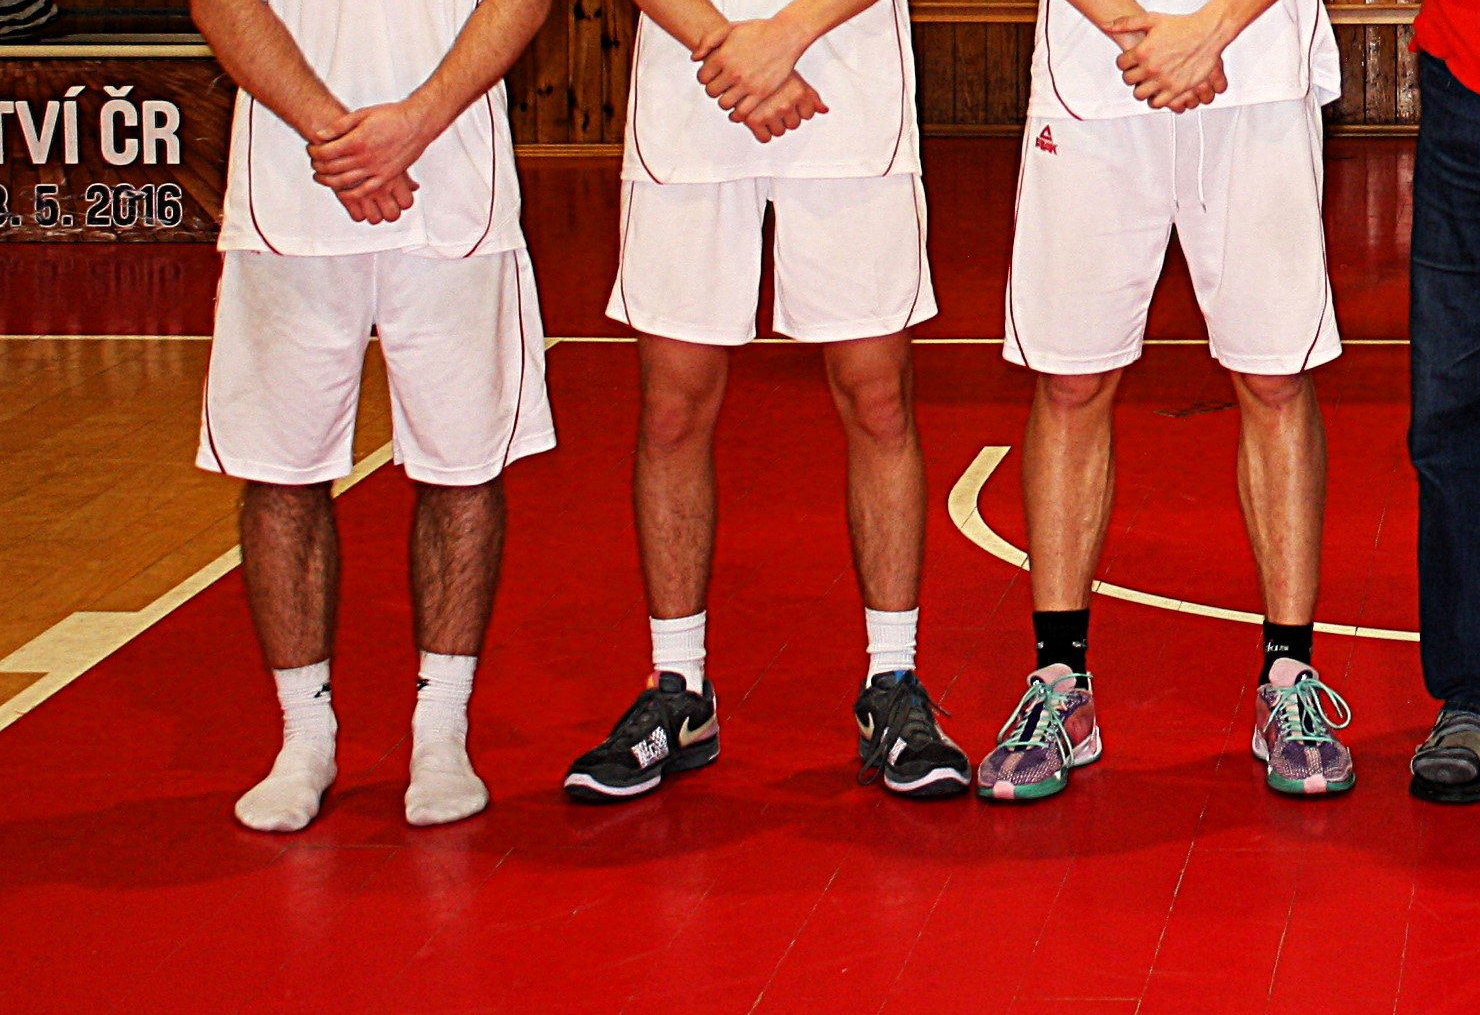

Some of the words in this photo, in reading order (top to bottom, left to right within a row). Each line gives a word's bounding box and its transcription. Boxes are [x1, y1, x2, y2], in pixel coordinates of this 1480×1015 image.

[100, 85, 181, 166] ČR
[34, 183, 74, 228] 5.
[84, 182, 184, 228] 2016
